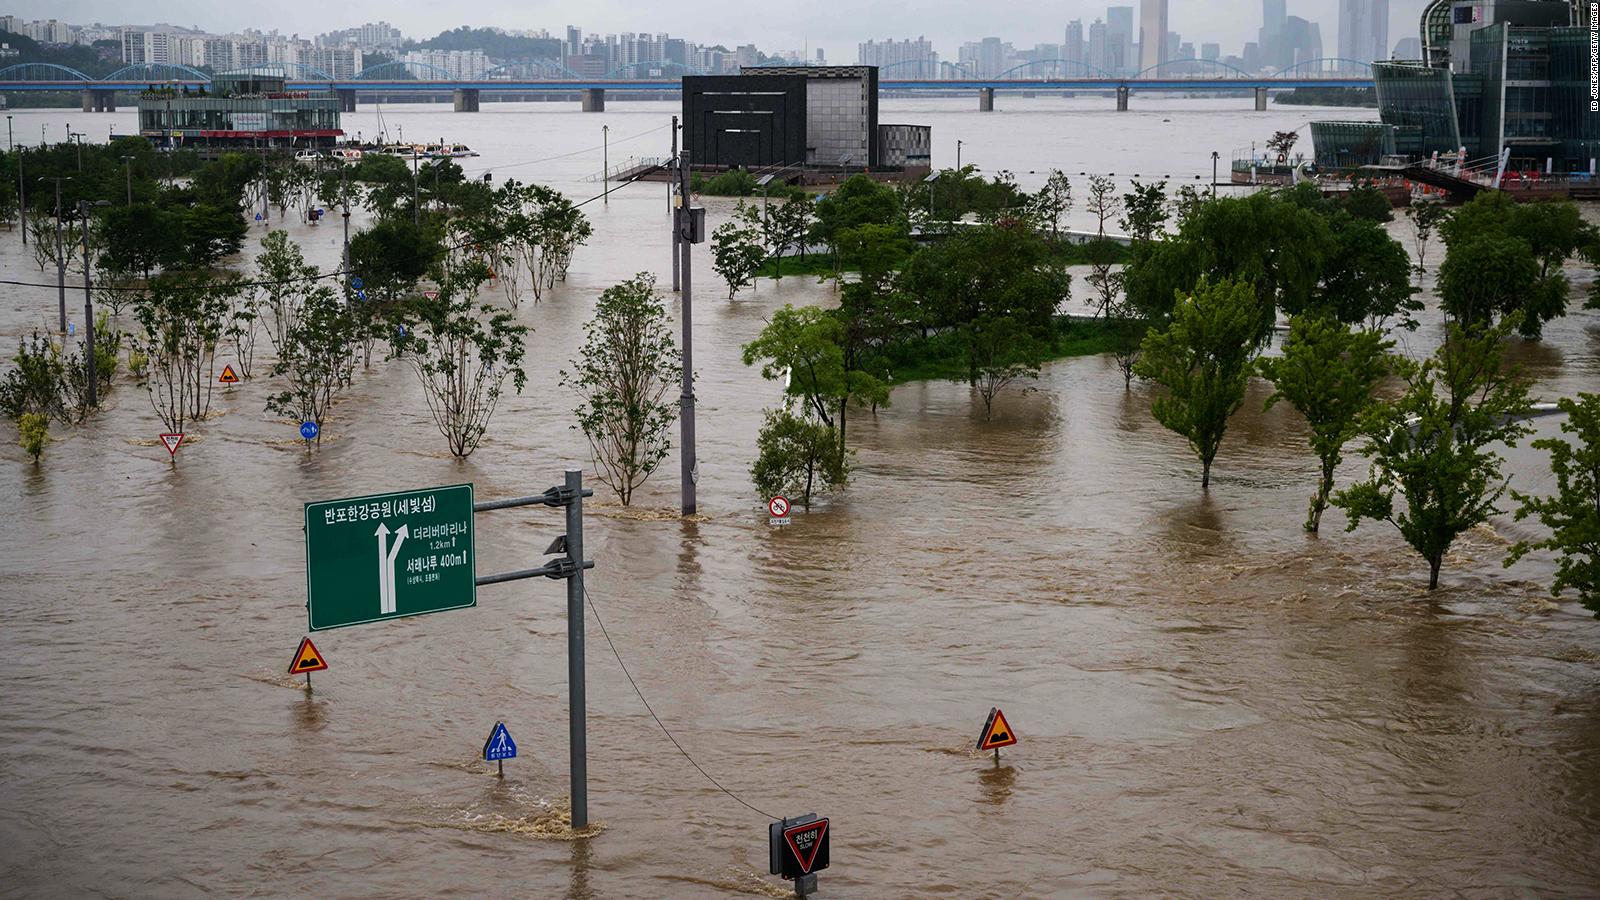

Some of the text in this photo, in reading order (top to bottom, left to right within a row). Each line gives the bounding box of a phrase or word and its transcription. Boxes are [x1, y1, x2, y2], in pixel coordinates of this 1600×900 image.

[324, 495, 436, 525] 반포한강공원(세빛섬)
[413, 521, 467, 540] 더리버마리나
[430, 541, 451, 550] 1.2km
[407, 553, 462, 573] 서래나루 400m
[796, 829, 818, 844] 천천히
[799, 841, 813, 850] SLOW
